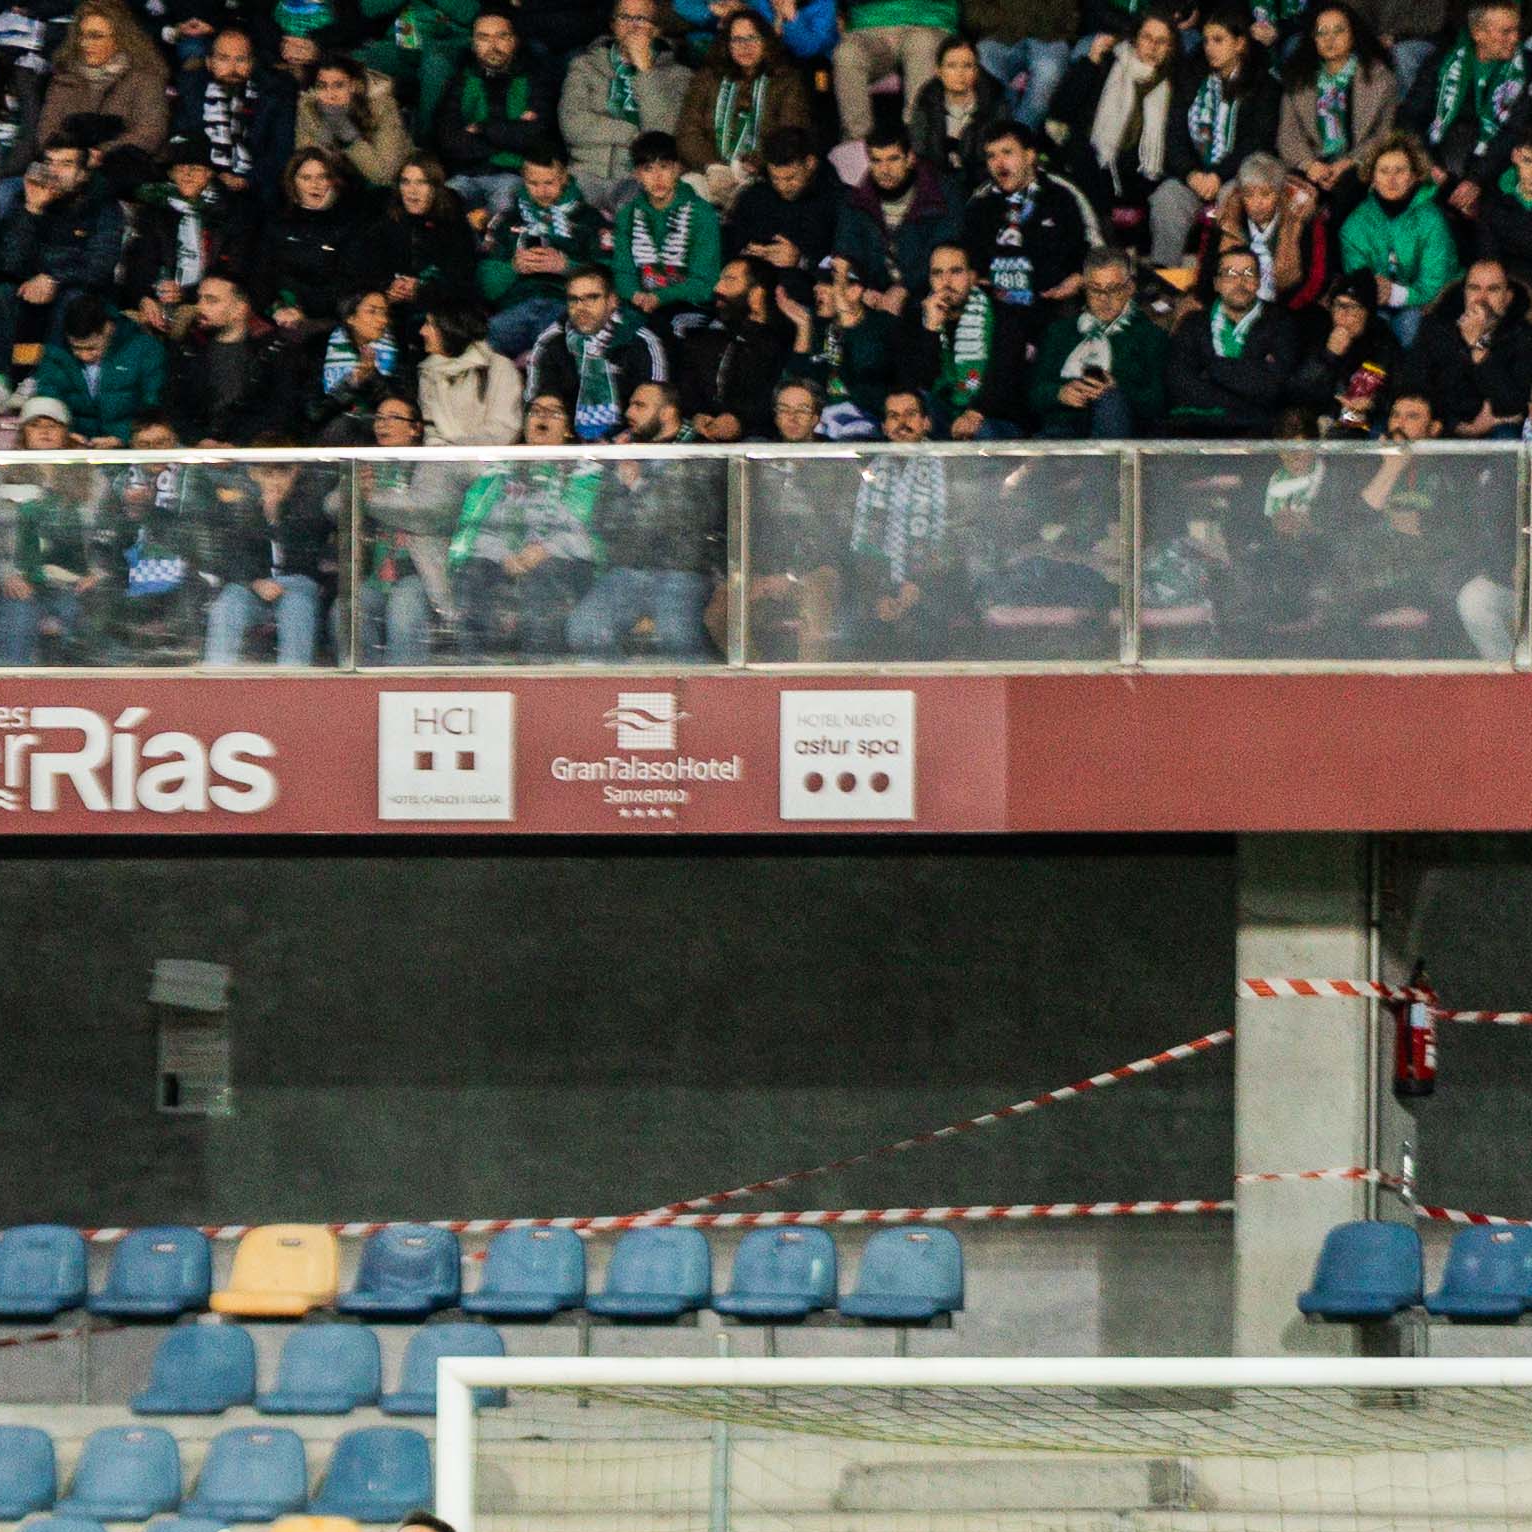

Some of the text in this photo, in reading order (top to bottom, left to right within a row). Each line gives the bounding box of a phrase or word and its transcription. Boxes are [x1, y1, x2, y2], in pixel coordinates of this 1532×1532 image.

[797, 713, 896, 728] HOTEL NUEVO
[794, 735, 900, 758] astur spa
